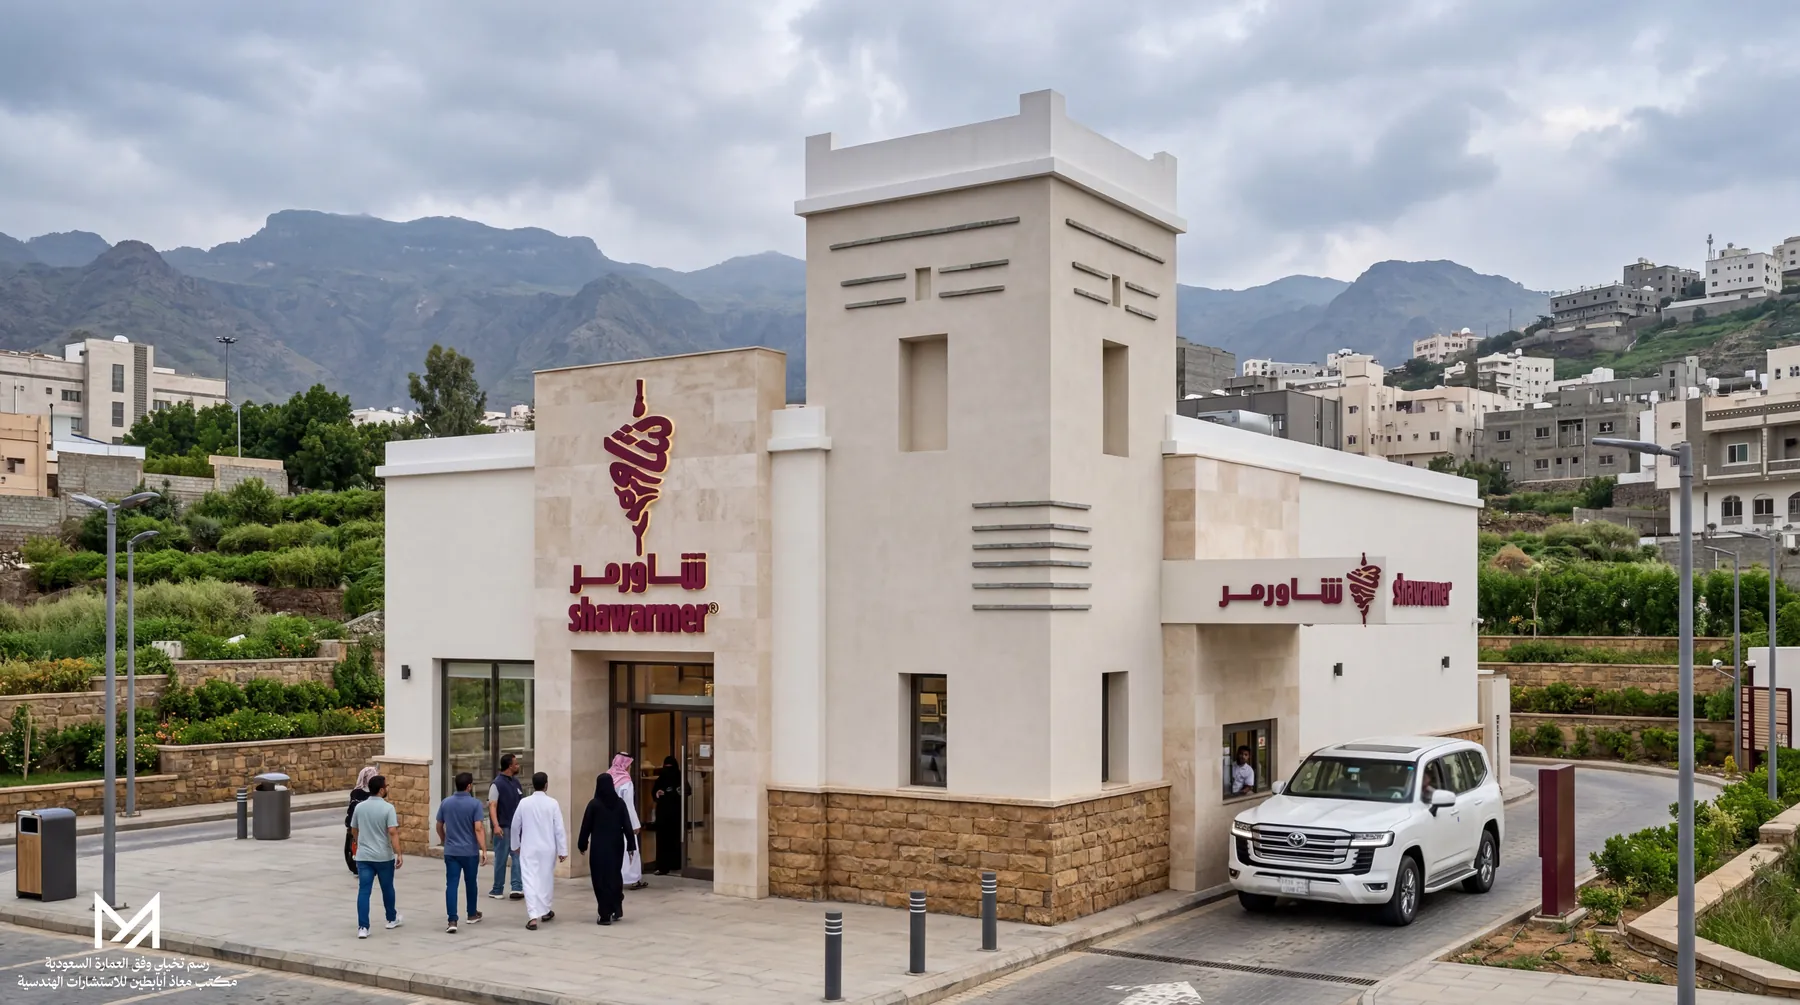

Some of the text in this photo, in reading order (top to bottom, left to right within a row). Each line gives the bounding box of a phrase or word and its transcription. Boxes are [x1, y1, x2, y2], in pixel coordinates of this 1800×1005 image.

[569, 553, 707, 594] شاورمر
[1392, 573, 1453, 607] shawarmer
[1219, 577, 1343, 608] شاورمر
